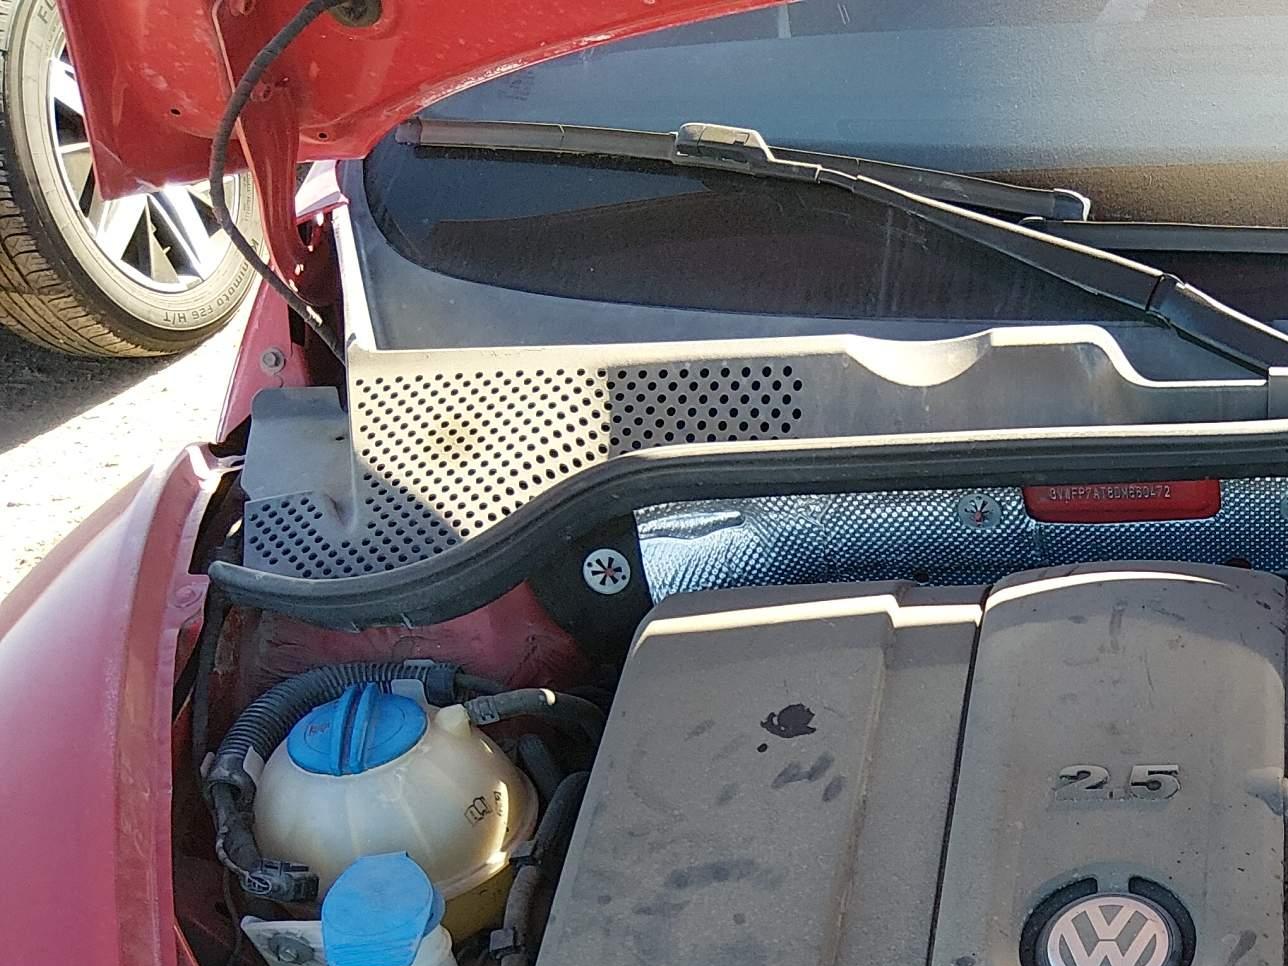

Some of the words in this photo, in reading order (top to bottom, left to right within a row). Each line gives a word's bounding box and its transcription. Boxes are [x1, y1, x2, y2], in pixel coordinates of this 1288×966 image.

[216, 238, 260, 307] Knimoto
[163, 311, 187, 325] H/T
[191, 304, 214, 320] F26
[1054, 763, 1183, 801] 2.5
